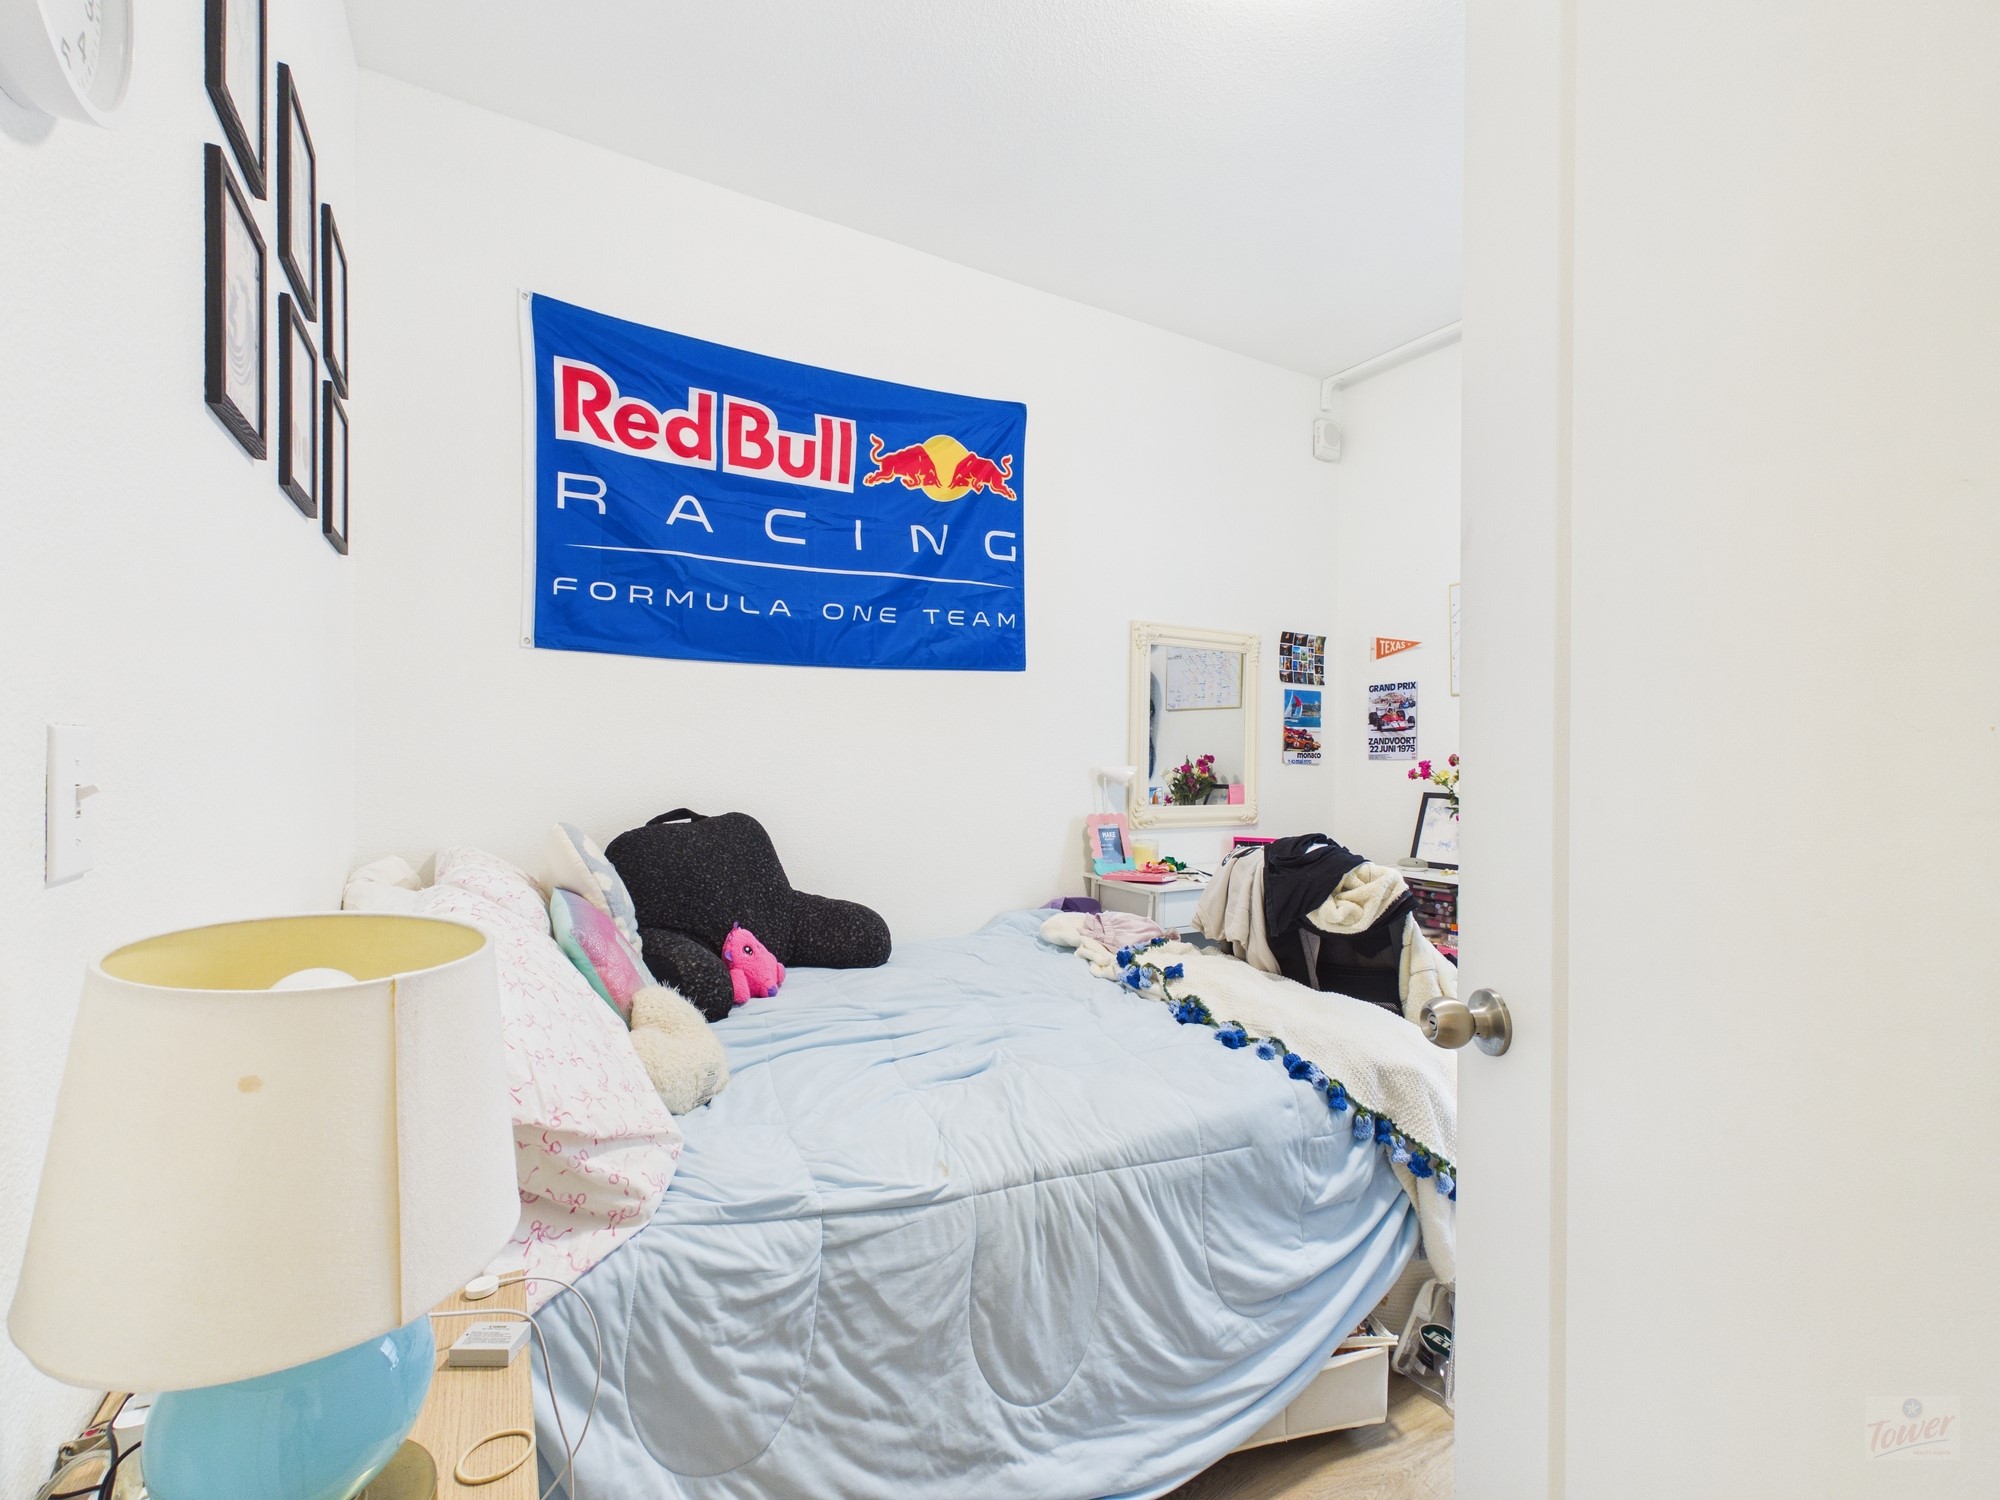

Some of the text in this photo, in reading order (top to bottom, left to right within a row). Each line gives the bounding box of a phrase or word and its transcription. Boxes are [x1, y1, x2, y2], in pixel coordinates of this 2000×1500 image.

[561, 363, 852, 485] Red Bull
[556, 471, 1016, 562] RACING
[553, 576, 1016, 629] FORMULA ONE TEAM
[1379, 640, 1406, 655] TEXAS
[1369, 681, 1417, 693] GRAND PRIX
[1368, 737, 1416, 745] ZANDVOORT
[1369, 744, 1416, 753] 22 JUNI 1975
[1423, 1331, 1452, 1351] JET
